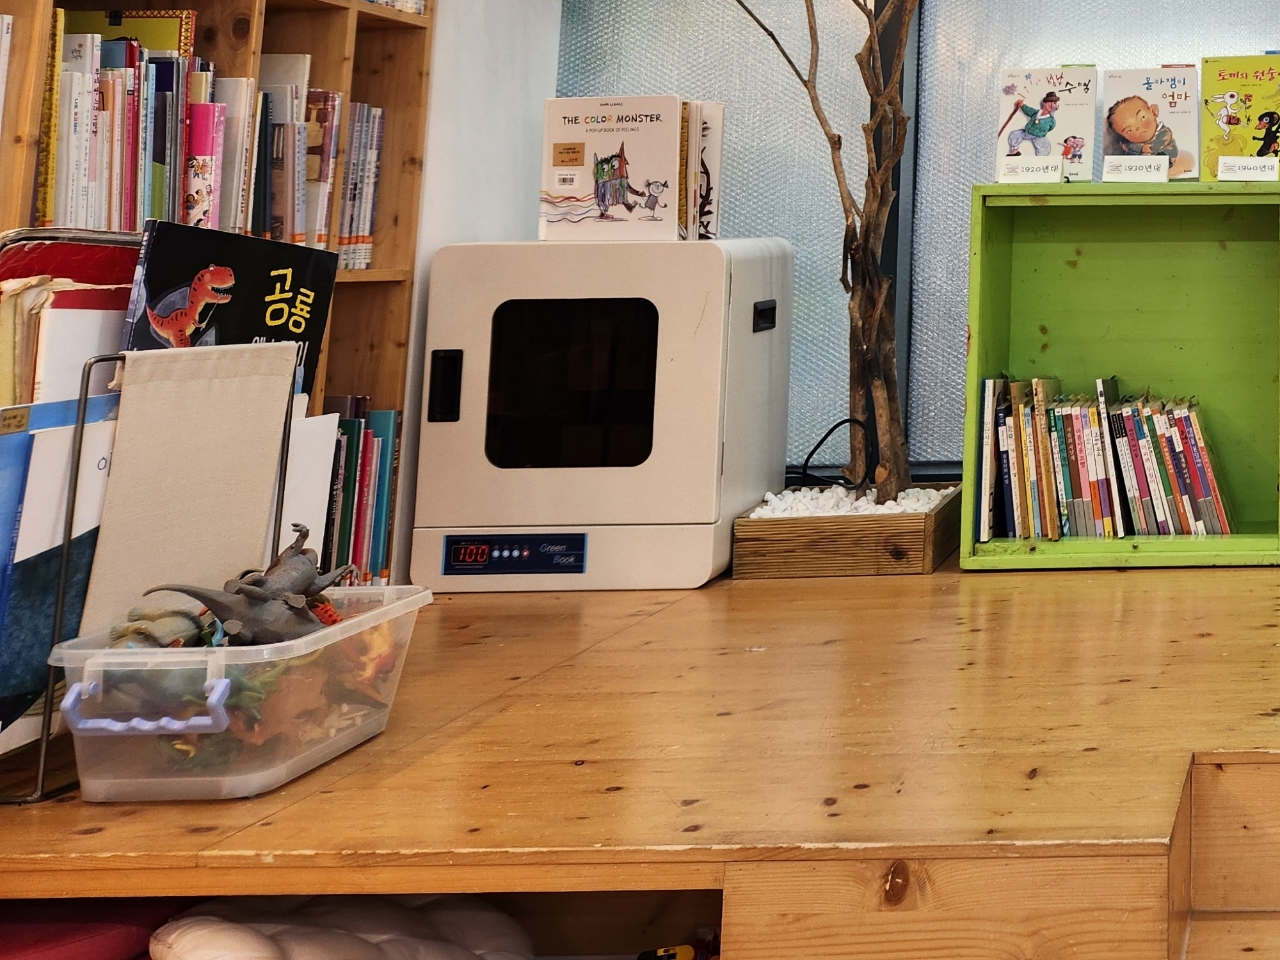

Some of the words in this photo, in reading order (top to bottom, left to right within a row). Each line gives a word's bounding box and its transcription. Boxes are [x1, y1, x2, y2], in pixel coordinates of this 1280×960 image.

[1217, 69, 1249, 82] 토끼와
[1142, 76, 1186, 91] 몰라쟁이
[1161, 91, 1191, 108] 엄마
[562, 115, 580, 126] THE
[584, 115, 613, 124] COLOR
[615, 113, 663, 124] MONSTER
[1020, 164, 1059, 175] 1920년대
[1124, 163, 1162, 174] 1930년대
[1237, 163, 1276, 173] 1940년대
[264, 267, 315, 334] 공룡
[459, 545, 489, 562] 100
[539, 543, 567, 553] Green
[553, 555, 576, 564] Book
